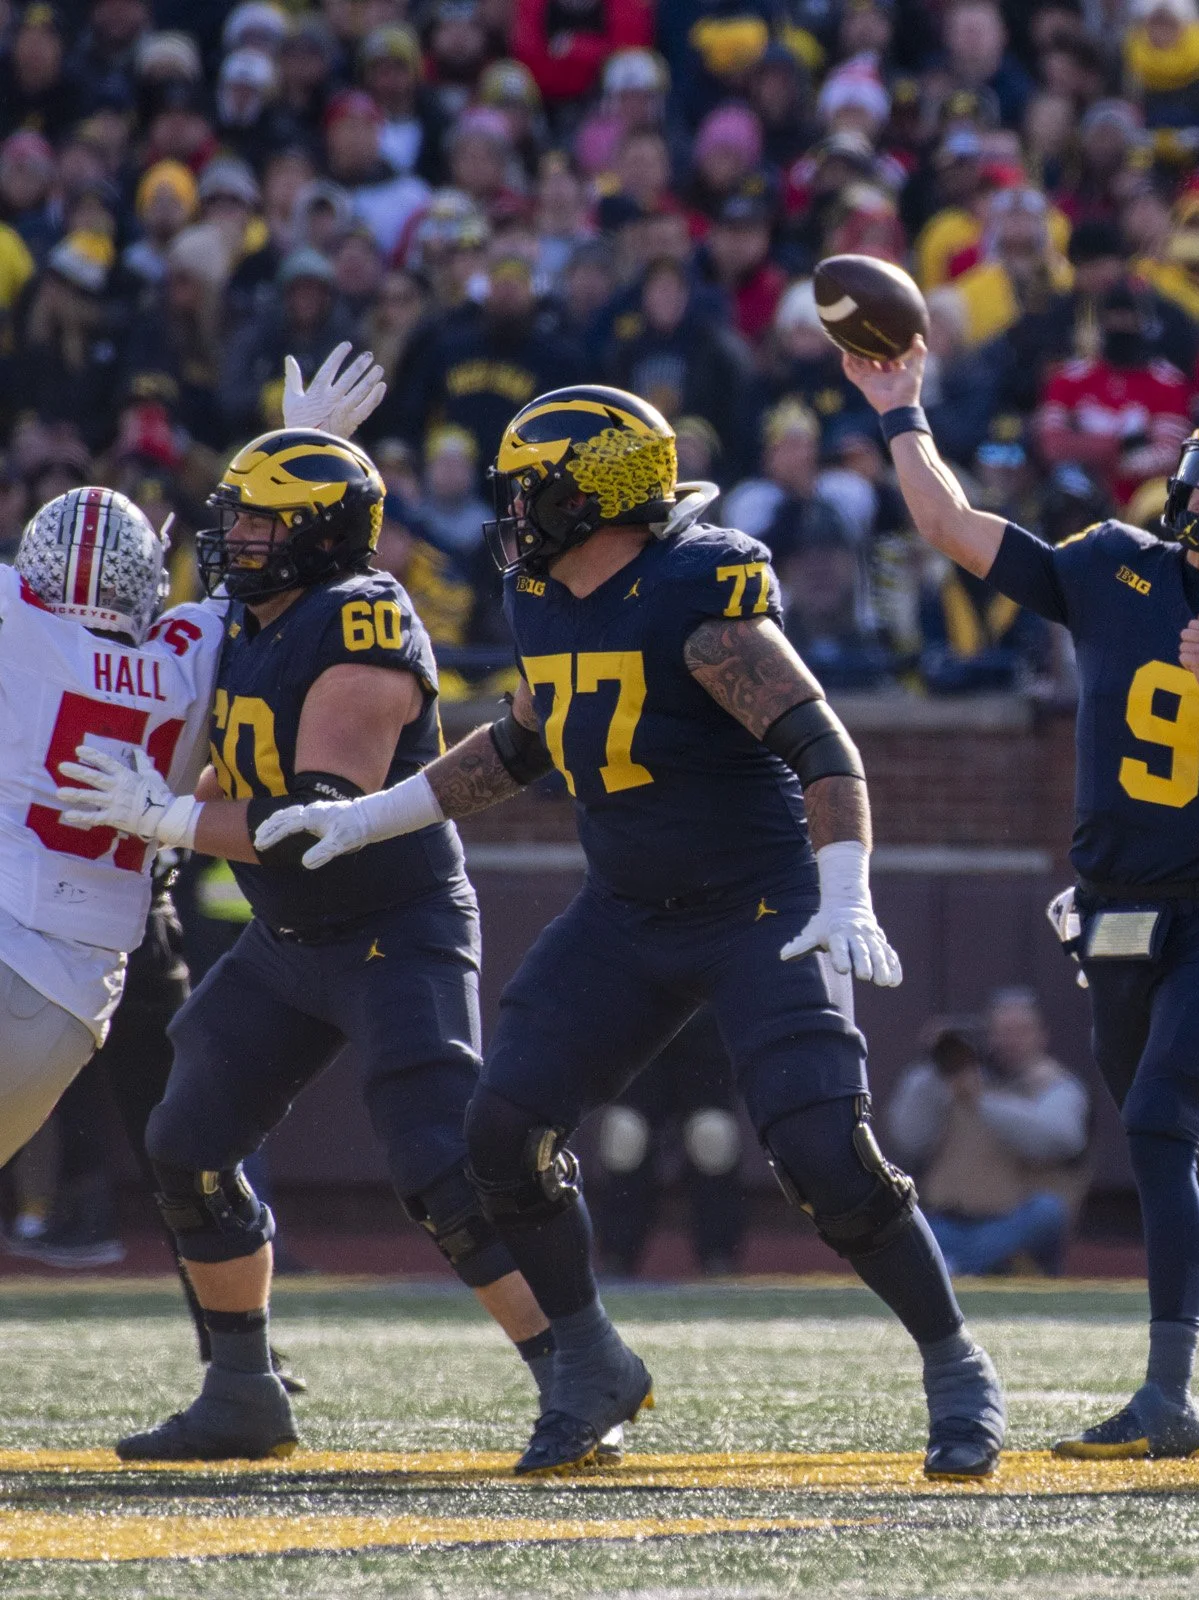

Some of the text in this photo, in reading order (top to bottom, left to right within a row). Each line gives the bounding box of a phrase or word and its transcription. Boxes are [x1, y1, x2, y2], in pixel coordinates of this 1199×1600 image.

[49, 606, 117, 621] UCKEYES
[716, 562, 770, 617] 77
[341, 600, 402, 651] 60
[94, 652, 166, 701] HALL
[521, 651, 654, 798] 77
